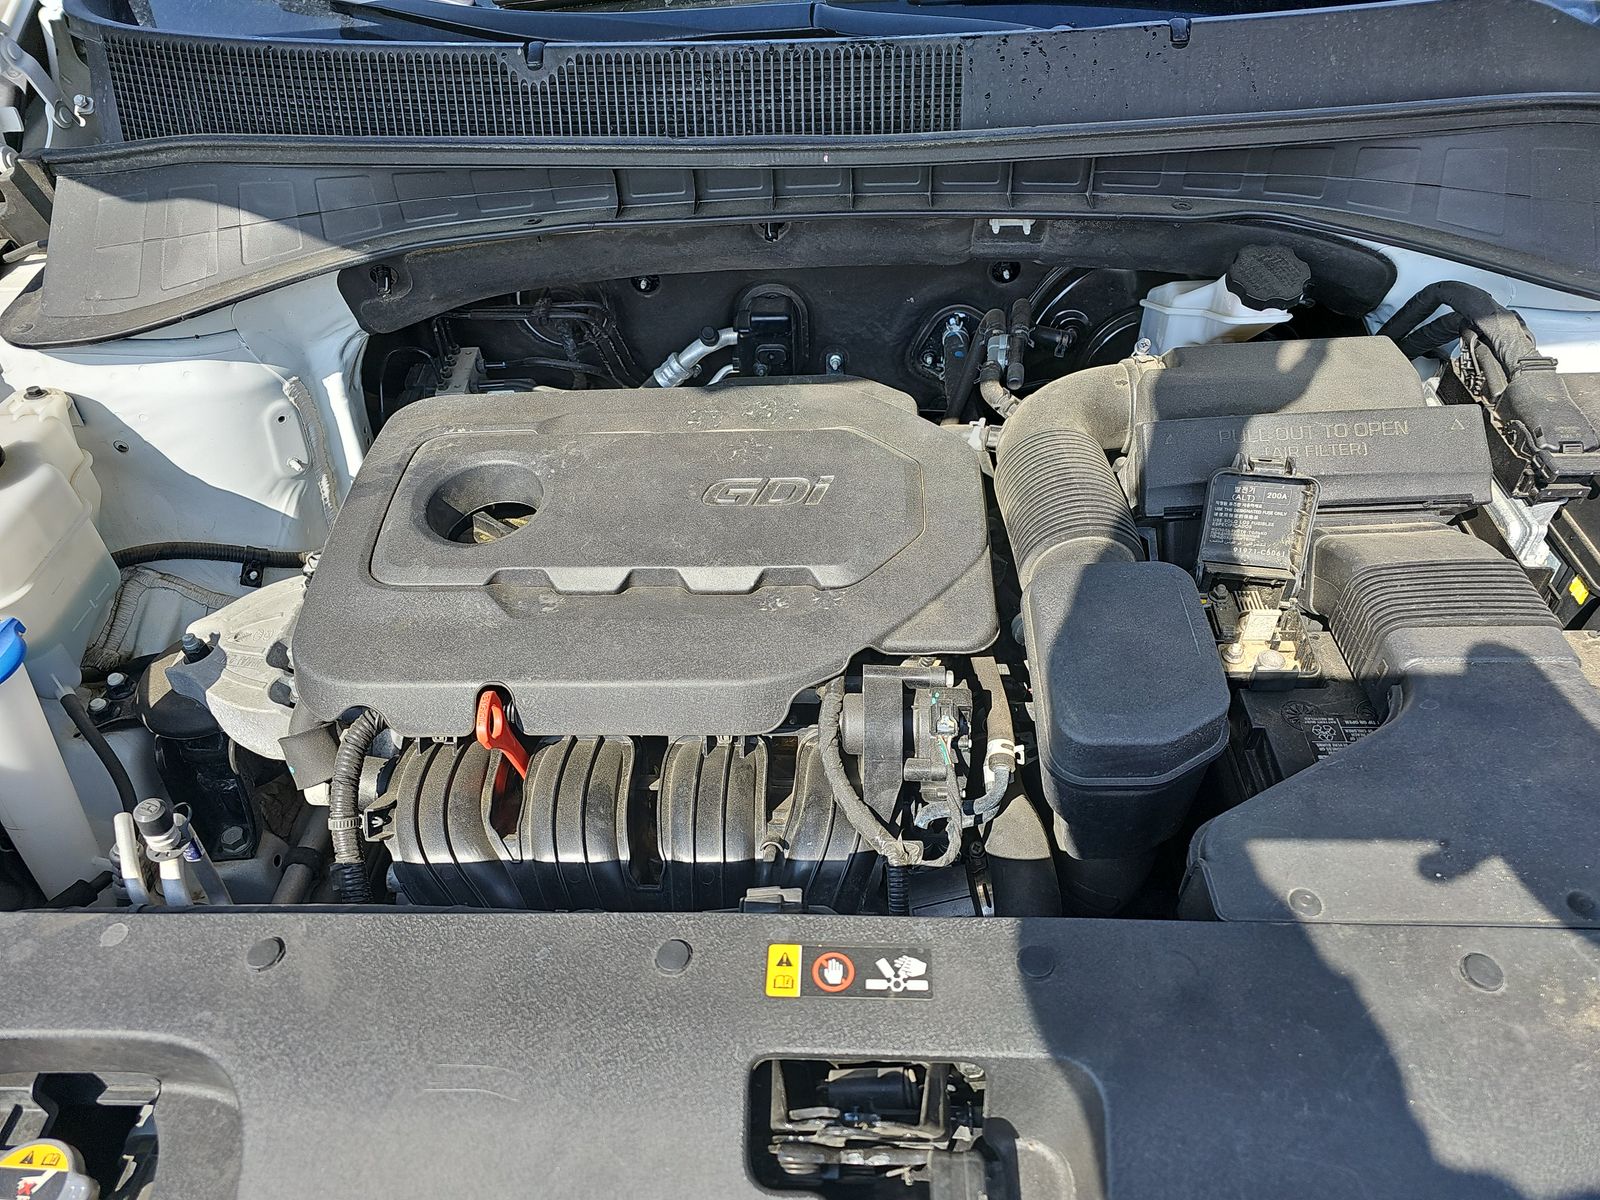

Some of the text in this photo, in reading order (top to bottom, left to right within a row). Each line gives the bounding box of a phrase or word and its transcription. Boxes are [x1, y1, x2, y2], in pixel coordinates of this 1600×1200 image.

[1218, 420, 1409, 445] PULL OUT TO OPEN
[701, 475, 835, 507] GDi
[1266, 492, 1287, 500] 200A
